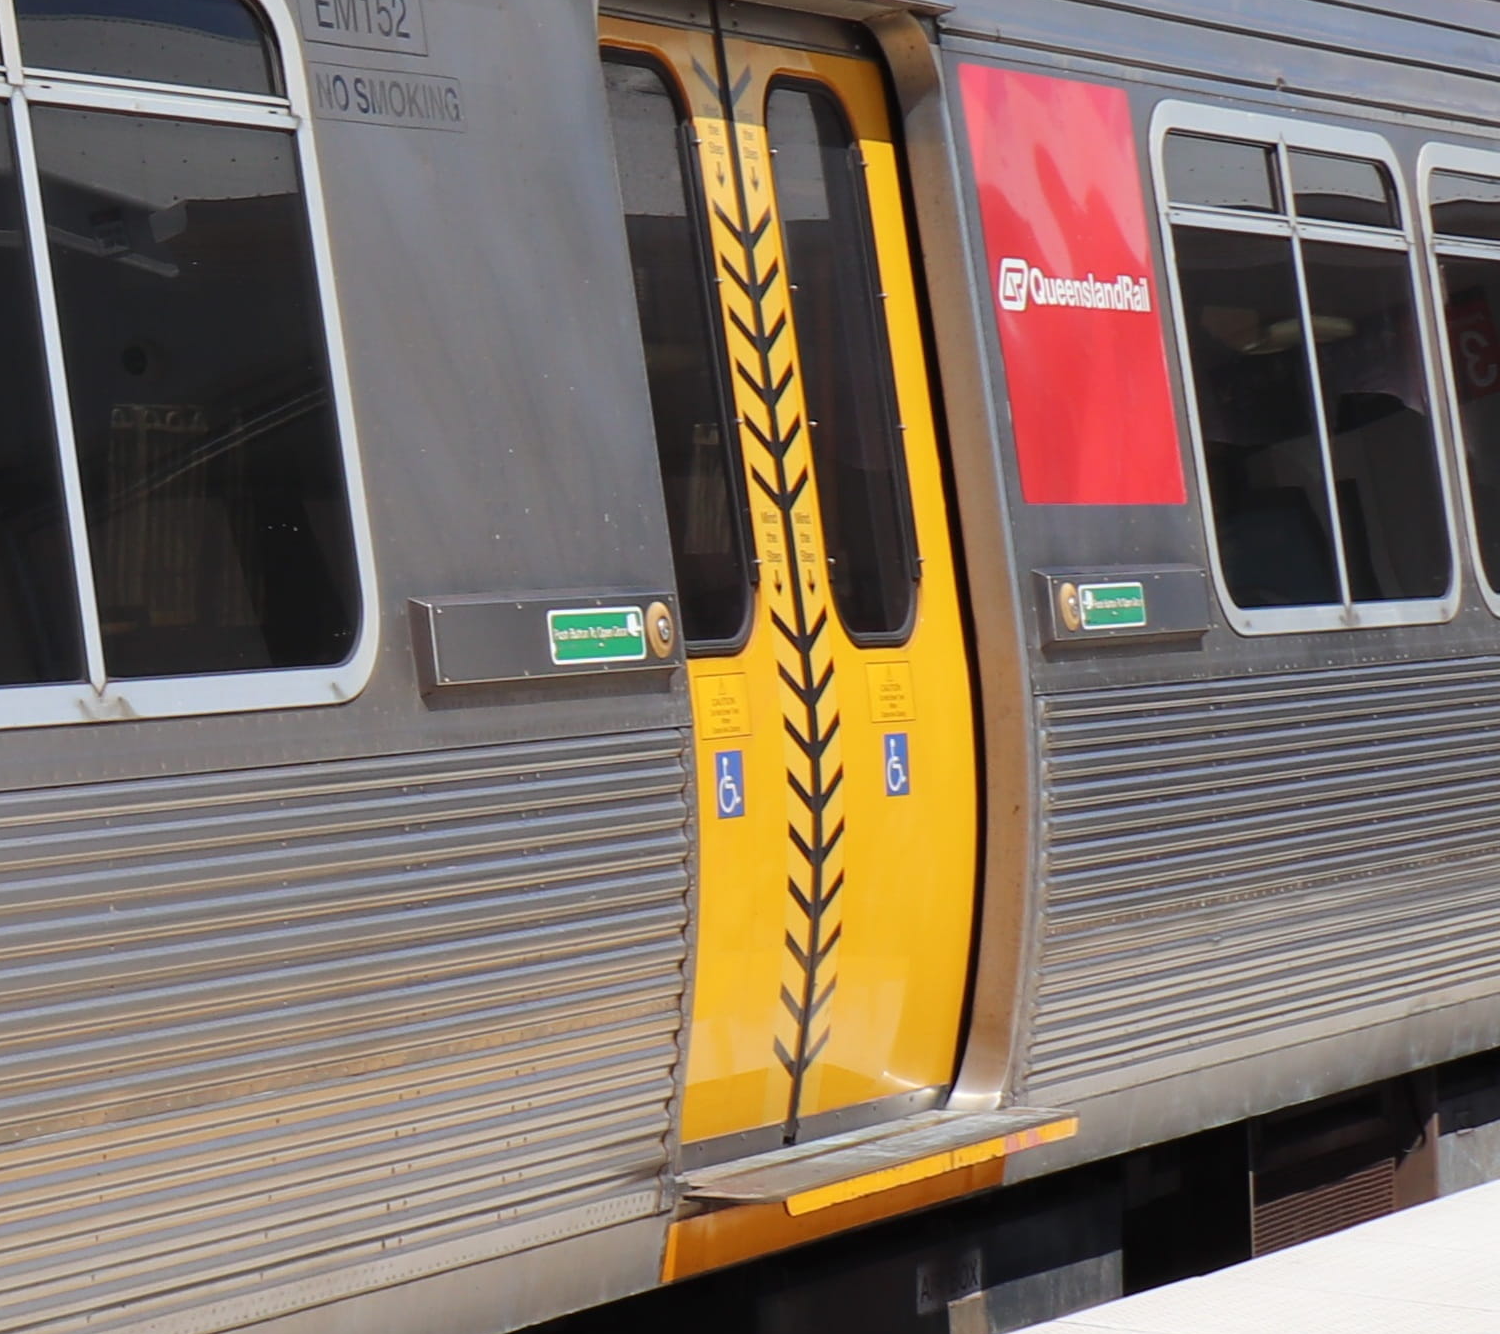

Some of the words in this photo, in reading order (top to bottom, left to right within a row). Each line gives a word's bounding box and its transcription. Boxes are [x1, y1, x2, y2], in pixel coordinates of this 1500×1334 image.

[316, 72, 349, 111] NO
[354, 78, 461, 121] SMOKING
[1029, 266, 1151, 313] QueenslandRail
